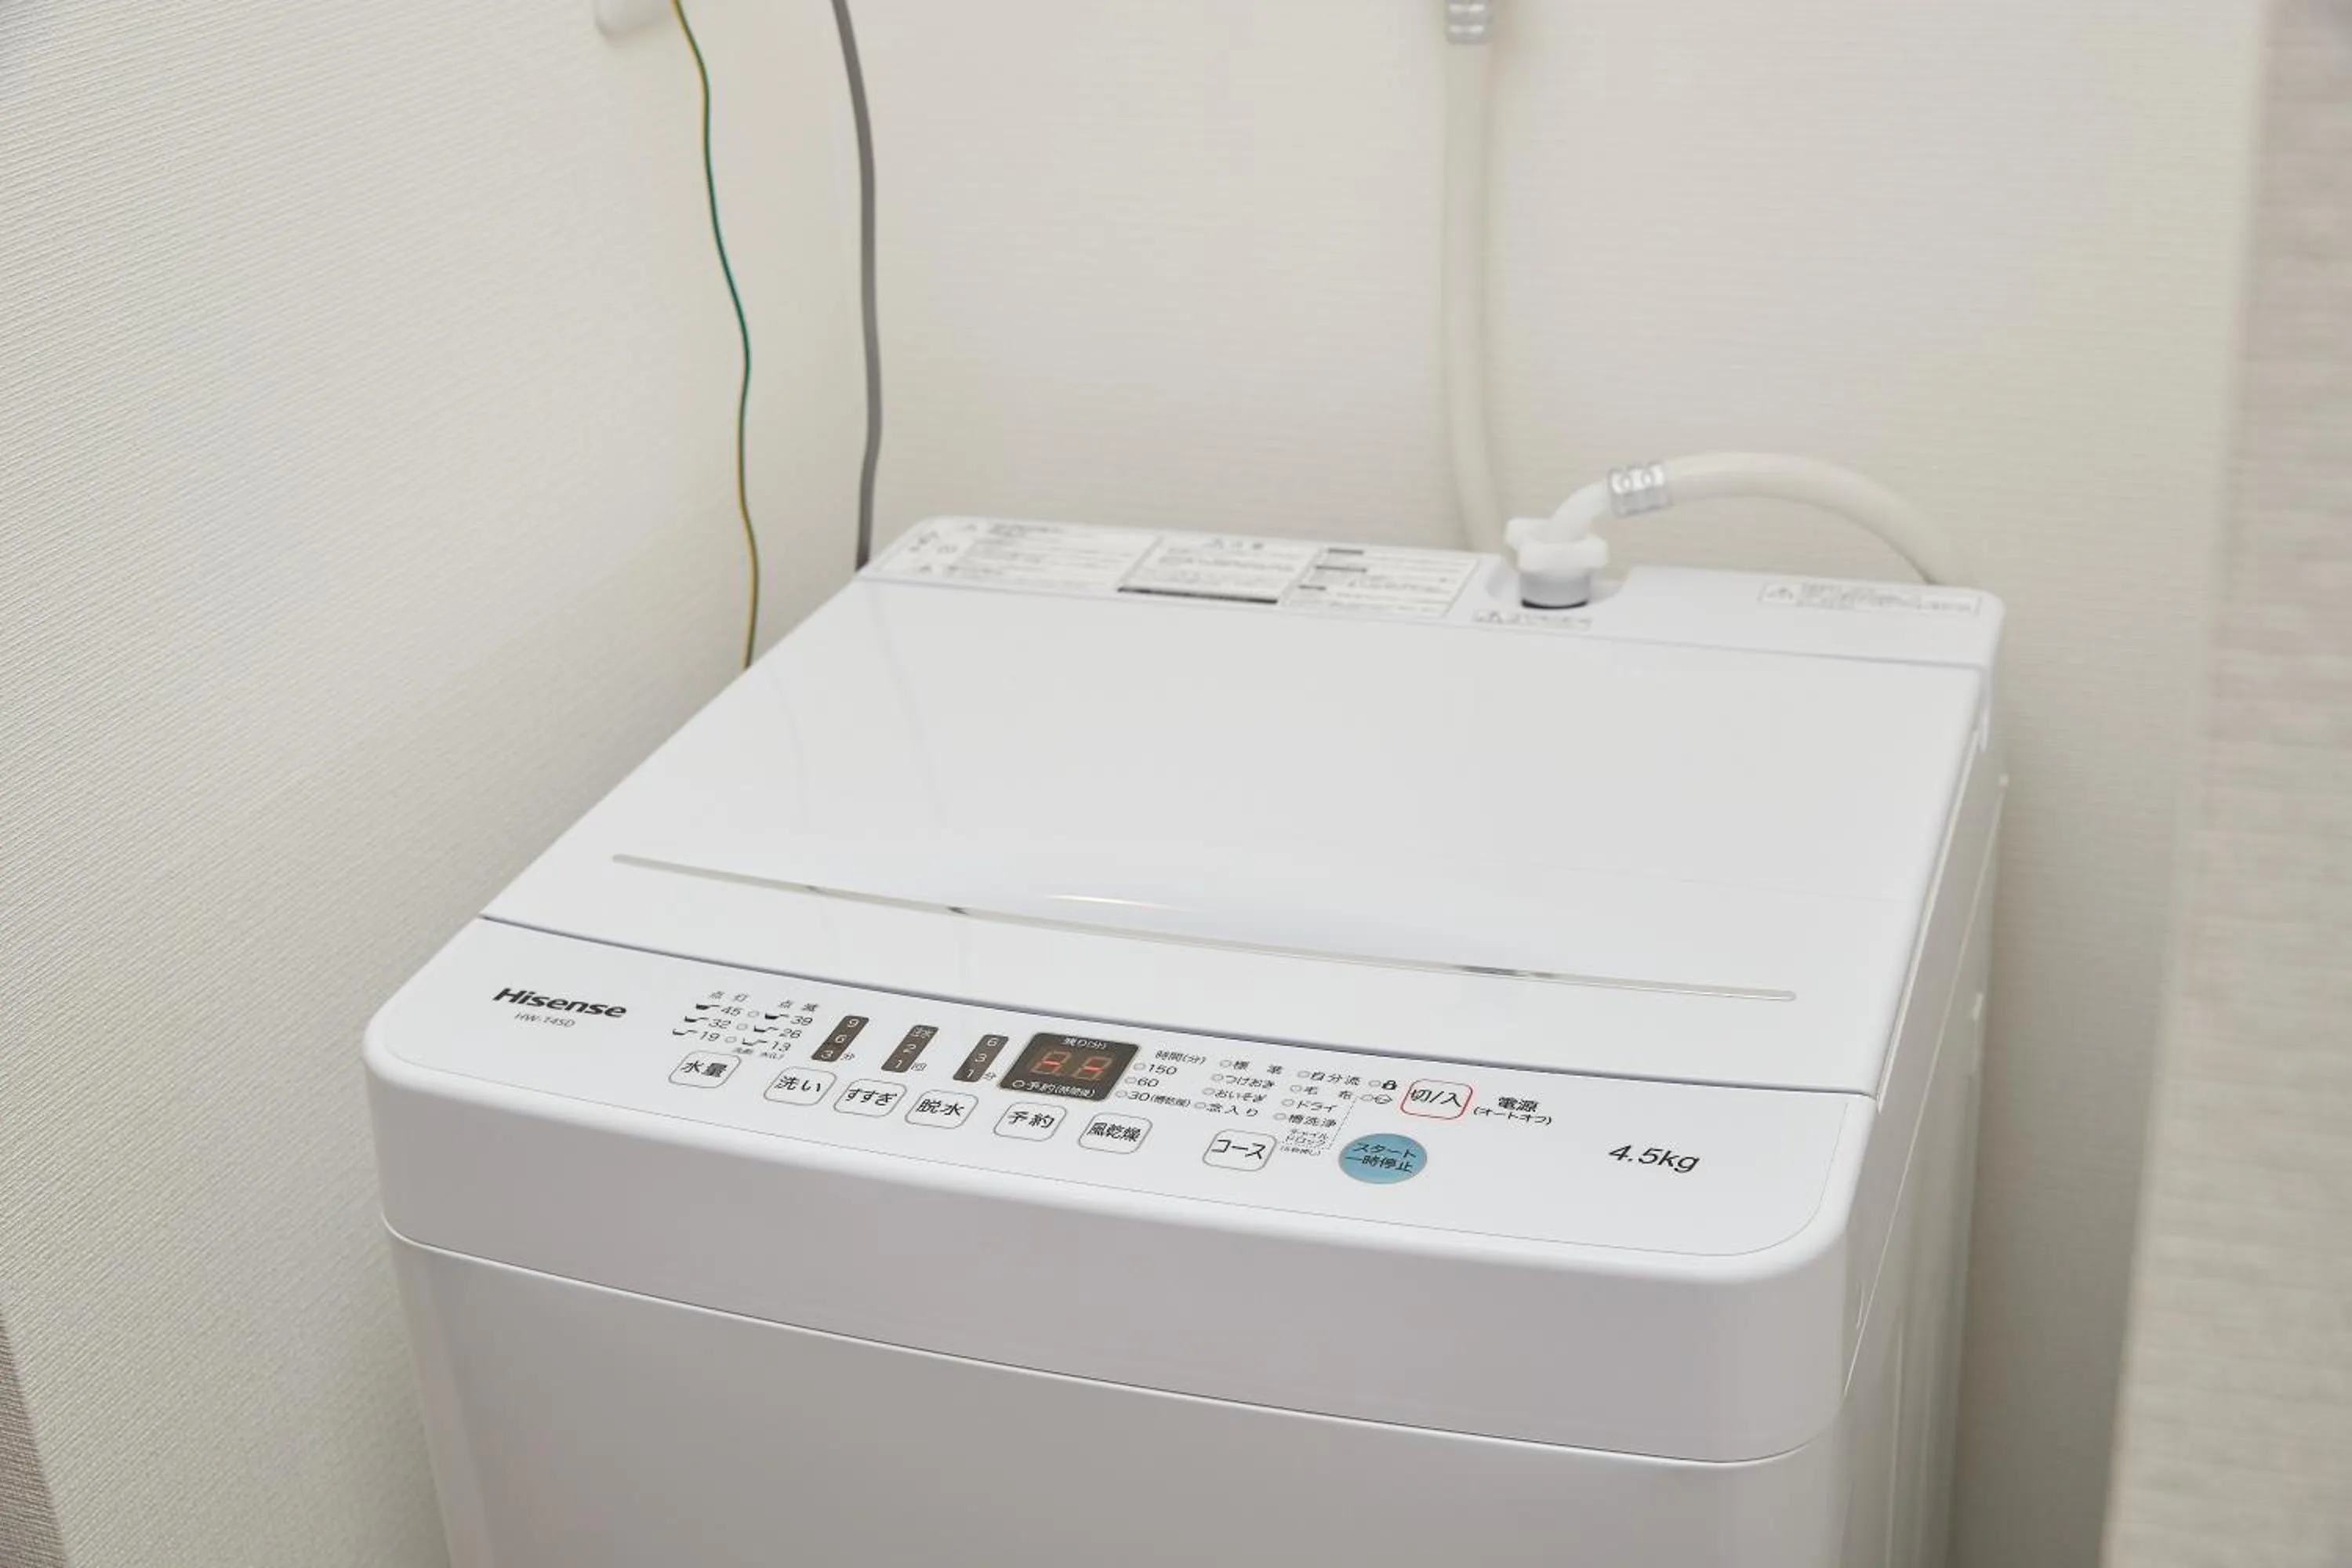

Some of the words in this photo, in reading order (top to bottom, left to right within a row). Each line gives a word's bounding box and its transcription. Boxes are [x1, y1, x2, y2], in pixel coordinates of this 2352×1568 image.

[492, 987, 627, 1018] Hisense
[720, 1006, 742, 1017] 45
[708, 1018, 731, 1029] 32
[790, 1016, 813, 1026] 39
[847, 1019, 860, 1029] 9
[699, 1031, 720, 1042] 19
[834, 1034, 848, 1044] 6
[821, 1050, 834, 1059] 3
[902, 1044, 916, 1054] 2
[974, 1053, 988, 1063] 3
[681, 1060, 728, 1078] 水量
[965, 1068, 975, 1078] 1
[1148, 1064, 1178, 1076] 150
[774, 1076, 821, 1092] 洗い
[1137, 1078, 1160, 1088] 60
[844, 1087, 898, 1106] すすぎ
[1410, 1088, 1462, 1107] 切/入
[1497, 1096, 1539, 1113] 電源
[916, 1099, 965, 1117] 脱水
[1007, 1110, 1055, 1129] 予約
[1087, 1121, 1142, 1142] 風乾燥
[1210, 1138, 1267, 1160] コース
[1352, 1142, 1417, 1159] スタート
[1345, 1154, 1414, 1174] 一時停止
[1608, 1145, 1700, 1174] 4.5kg
